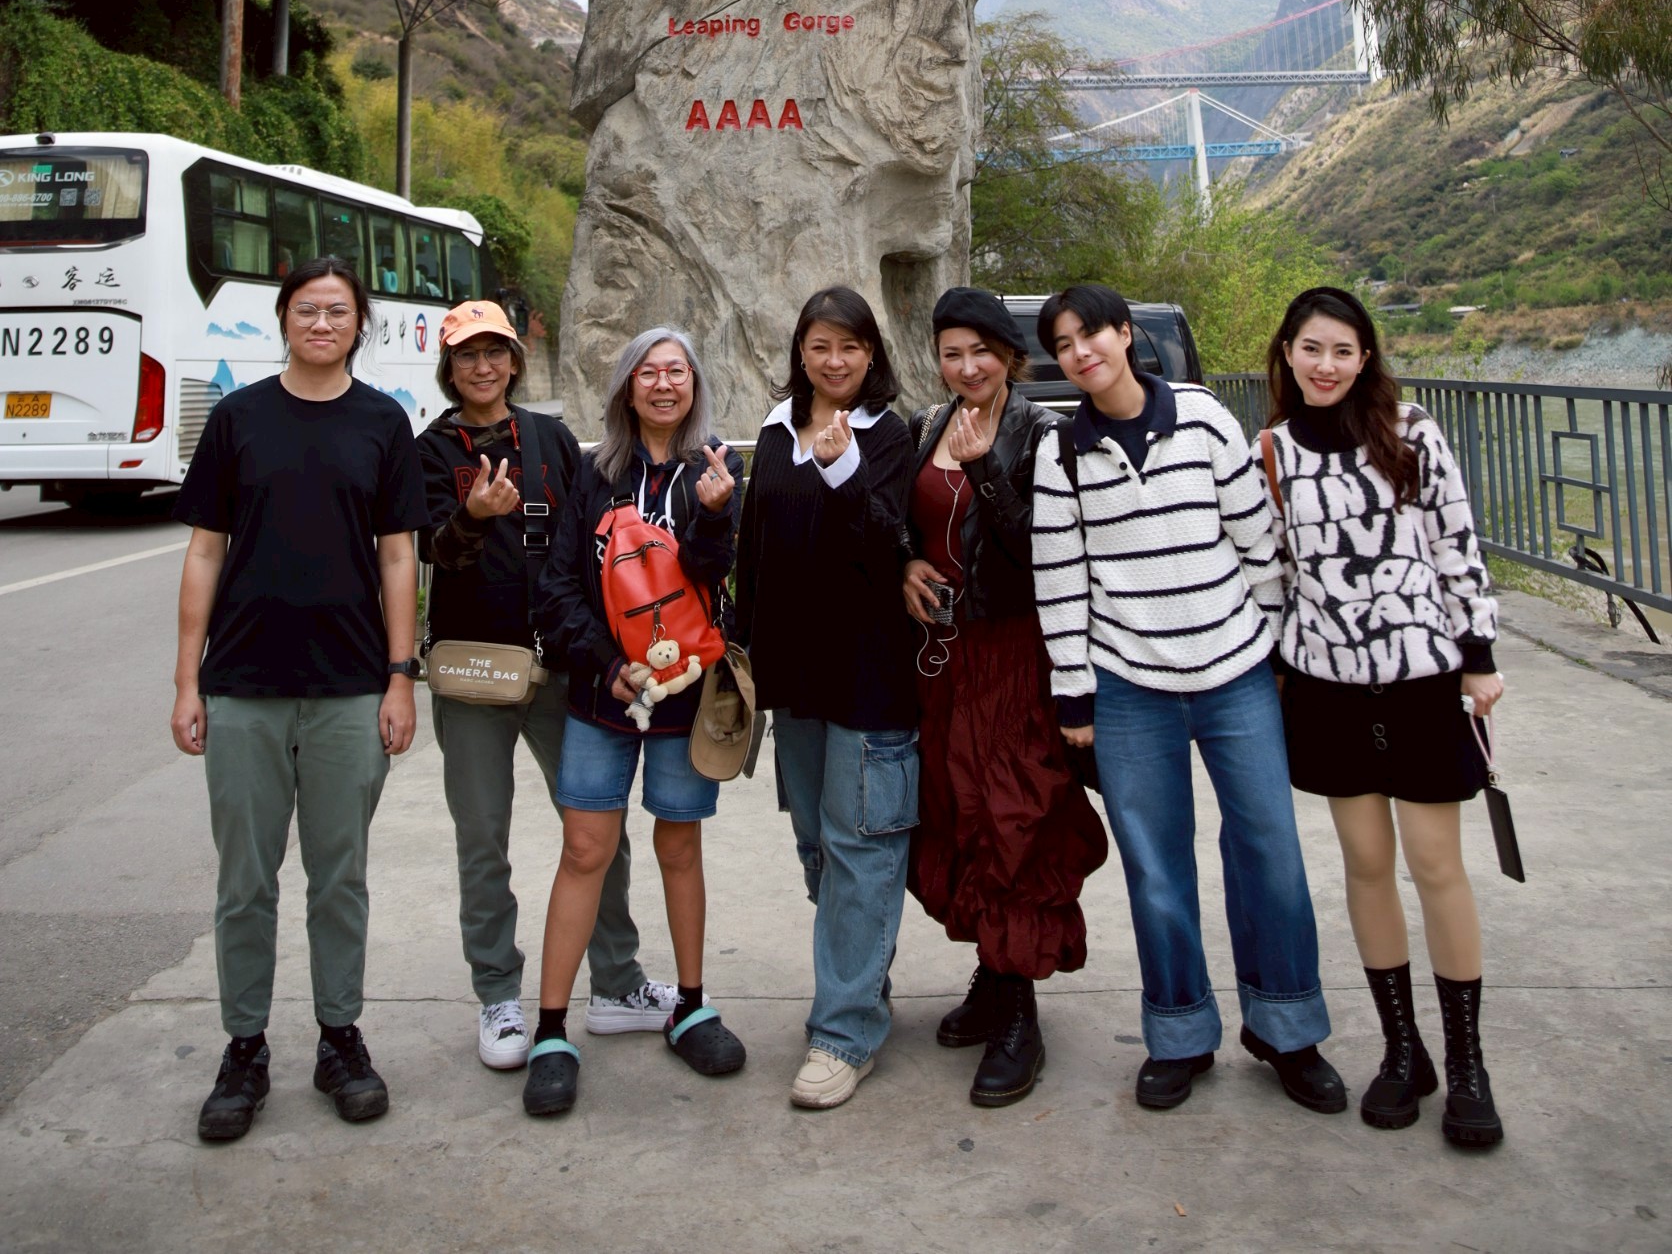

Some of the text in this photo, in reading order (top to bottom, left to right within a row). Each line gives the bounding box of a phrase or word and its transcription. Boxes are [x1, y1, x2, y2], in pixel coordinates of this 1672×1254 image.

[668, 12, 856, 40] Leaping Gorge
[18, 171, 95, 182] KING LONG
[2, 326, 114, 357] N2289
[6, 403, 48, 418] N2289
[469, 658, 492, 668] THE
[439, 665, 519, 681] CAMERA BAG
